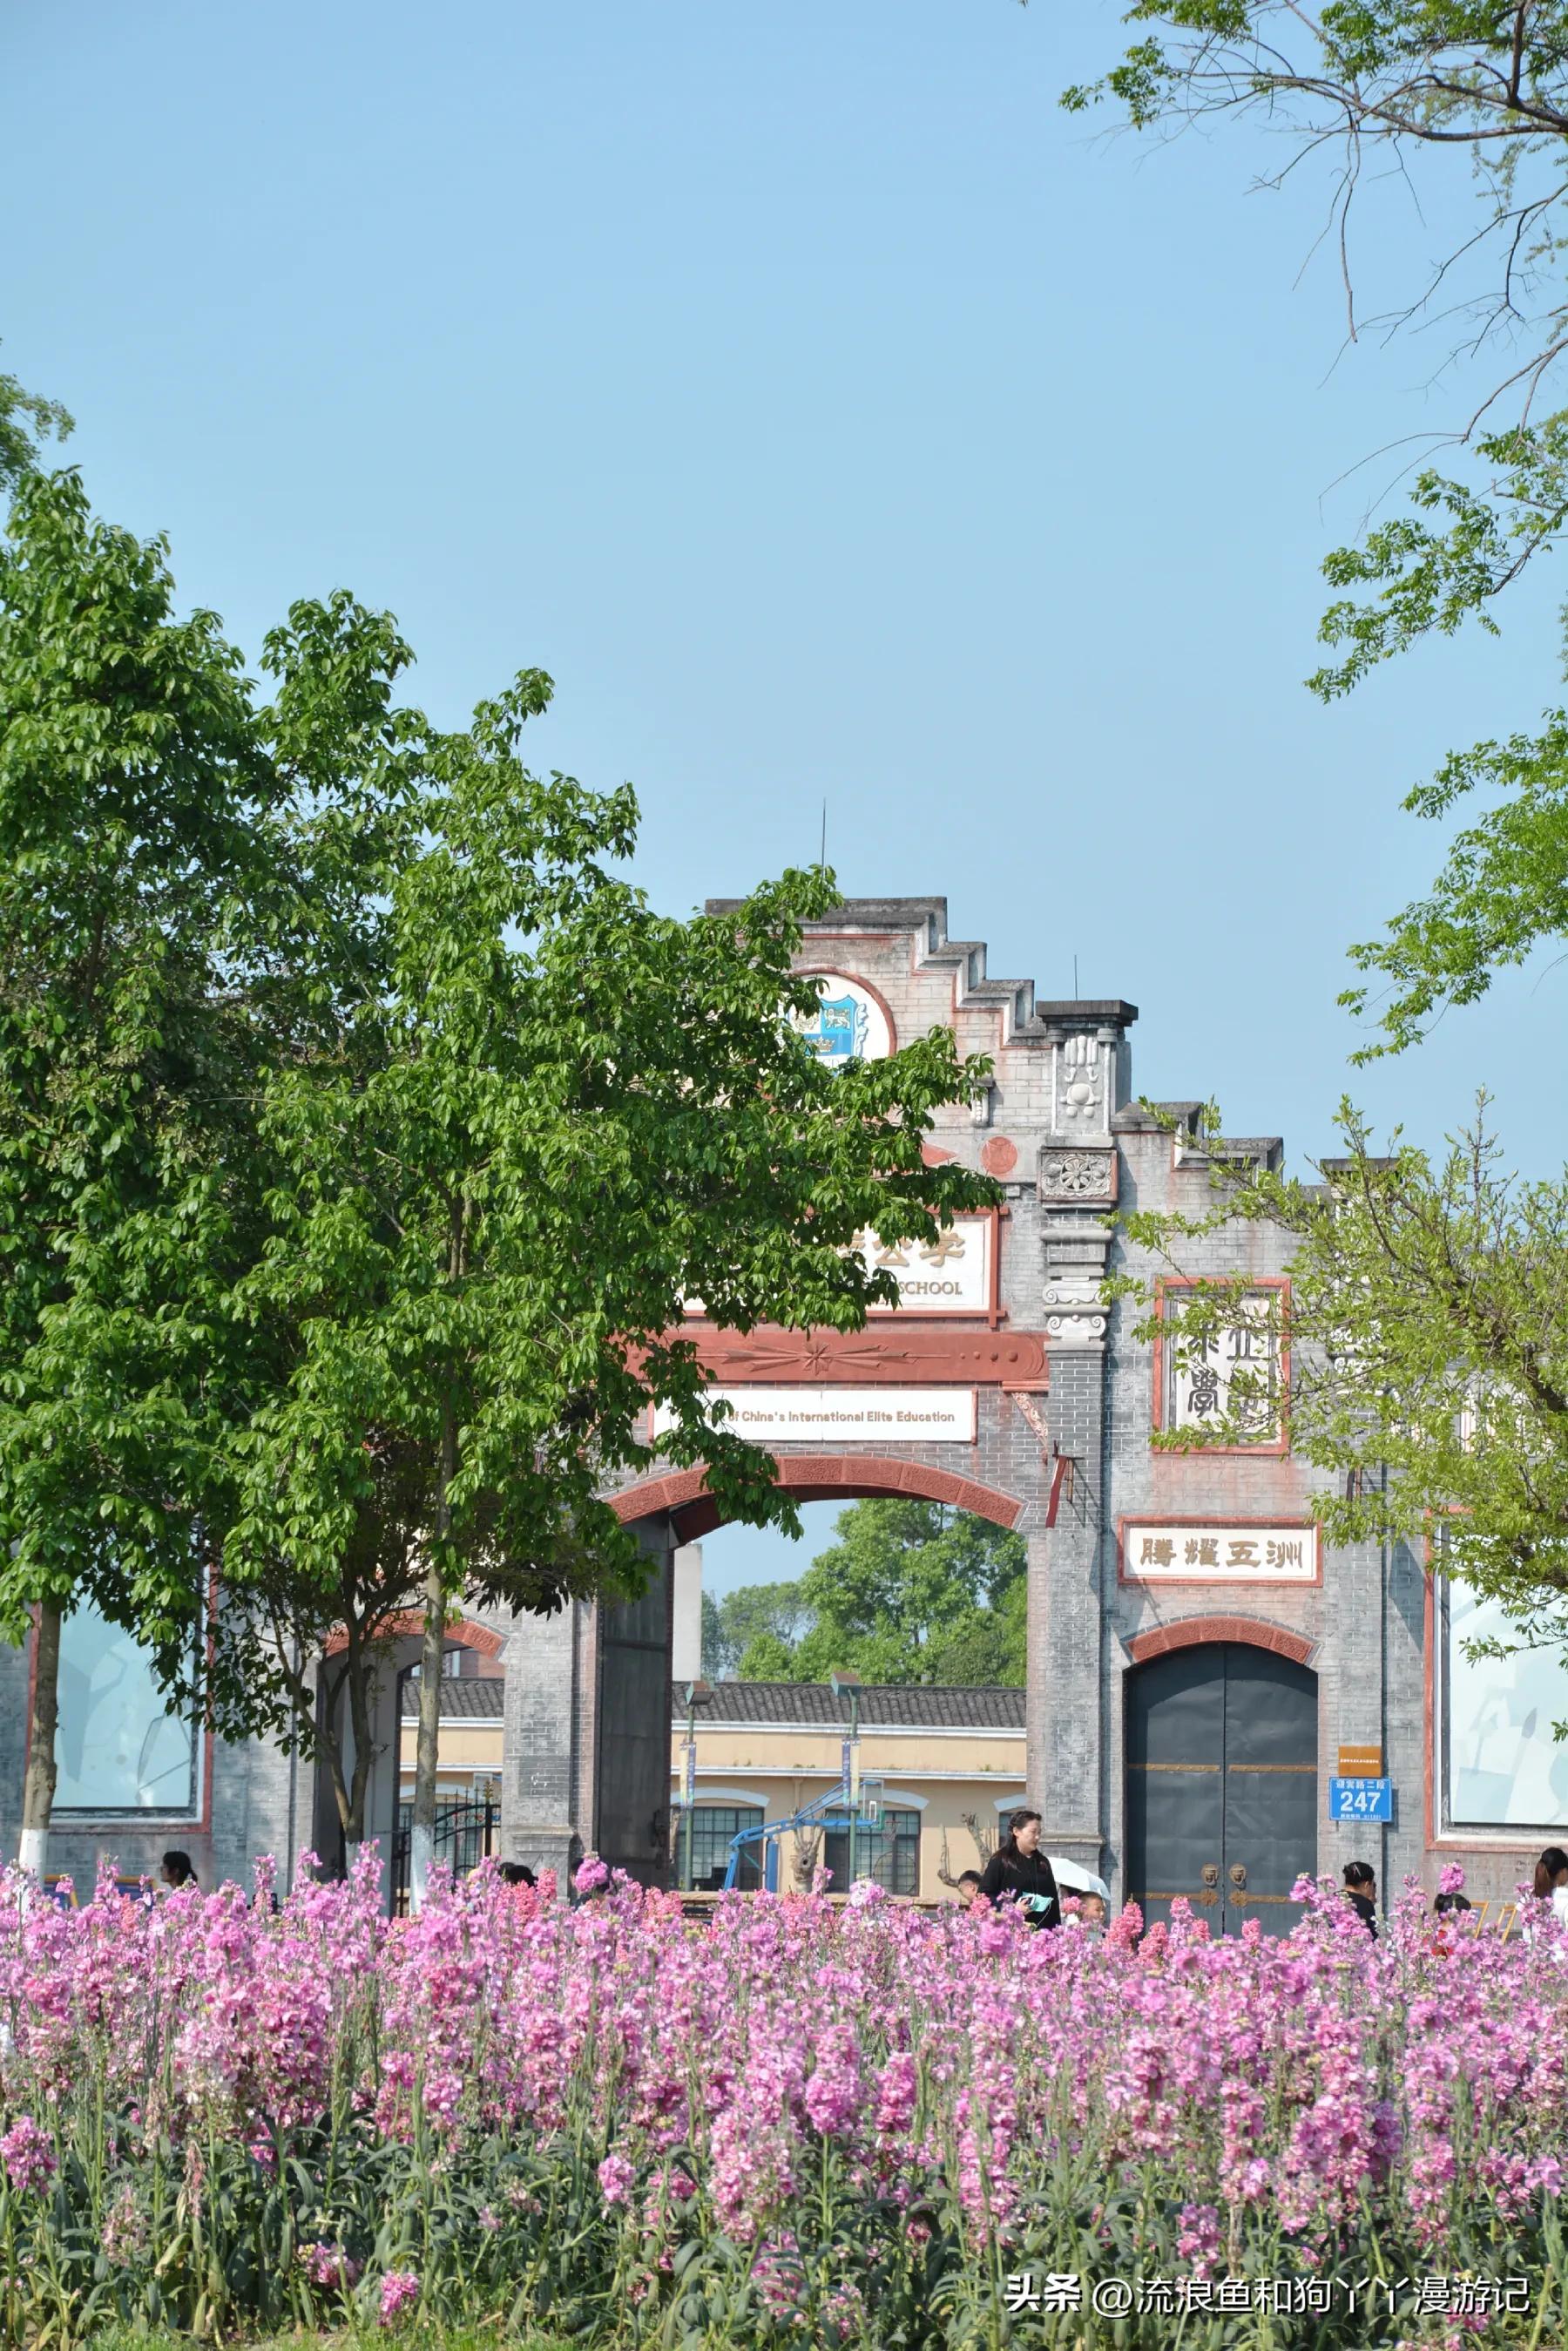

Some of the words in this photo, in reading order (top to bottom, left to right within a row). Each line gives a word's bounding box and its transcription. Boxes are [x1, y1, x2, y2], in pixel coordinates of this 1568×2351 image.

[898, 1281, 963, 1296] SCHOOL
[728, 1411, 739, 1422] of
[741, 1410, 786, 1422] China's
[788, 1410, 864, 1422] International
[867, 1410, 893, 1422] Elite
[896, 1410, 956, 1422] Education
[1340, 1791, 1381, 1812] 247
